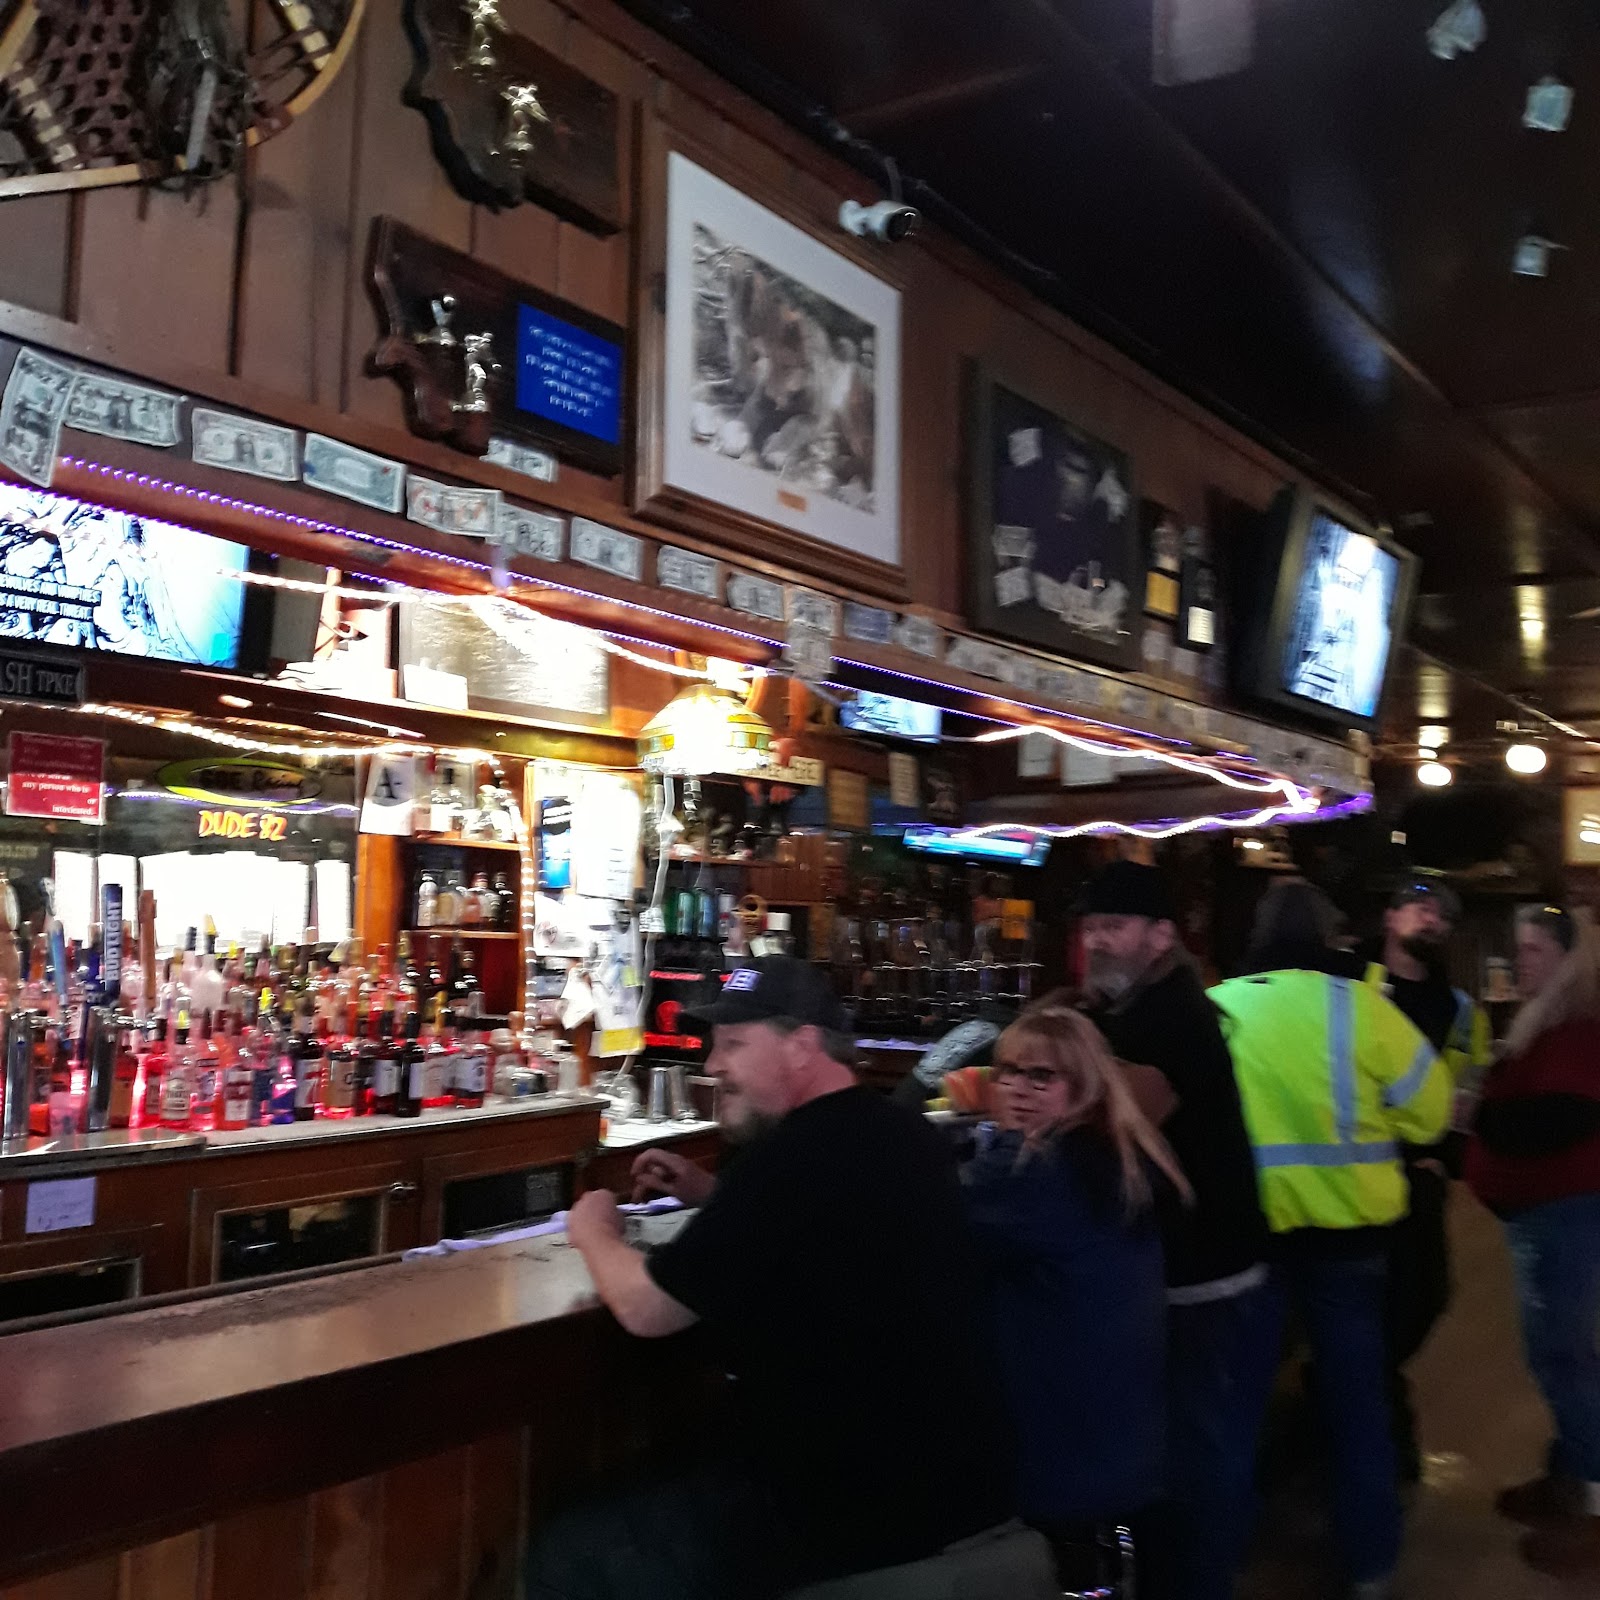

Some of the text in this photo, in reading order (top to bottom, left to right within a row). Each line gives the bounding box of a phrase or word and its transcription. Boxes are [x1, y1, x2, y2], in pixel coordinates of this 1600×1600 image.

[36, 599, 60, 615] REAL
[22, 782, 90, 794] any person who is
[198, 810, 259, 839] DUDE
